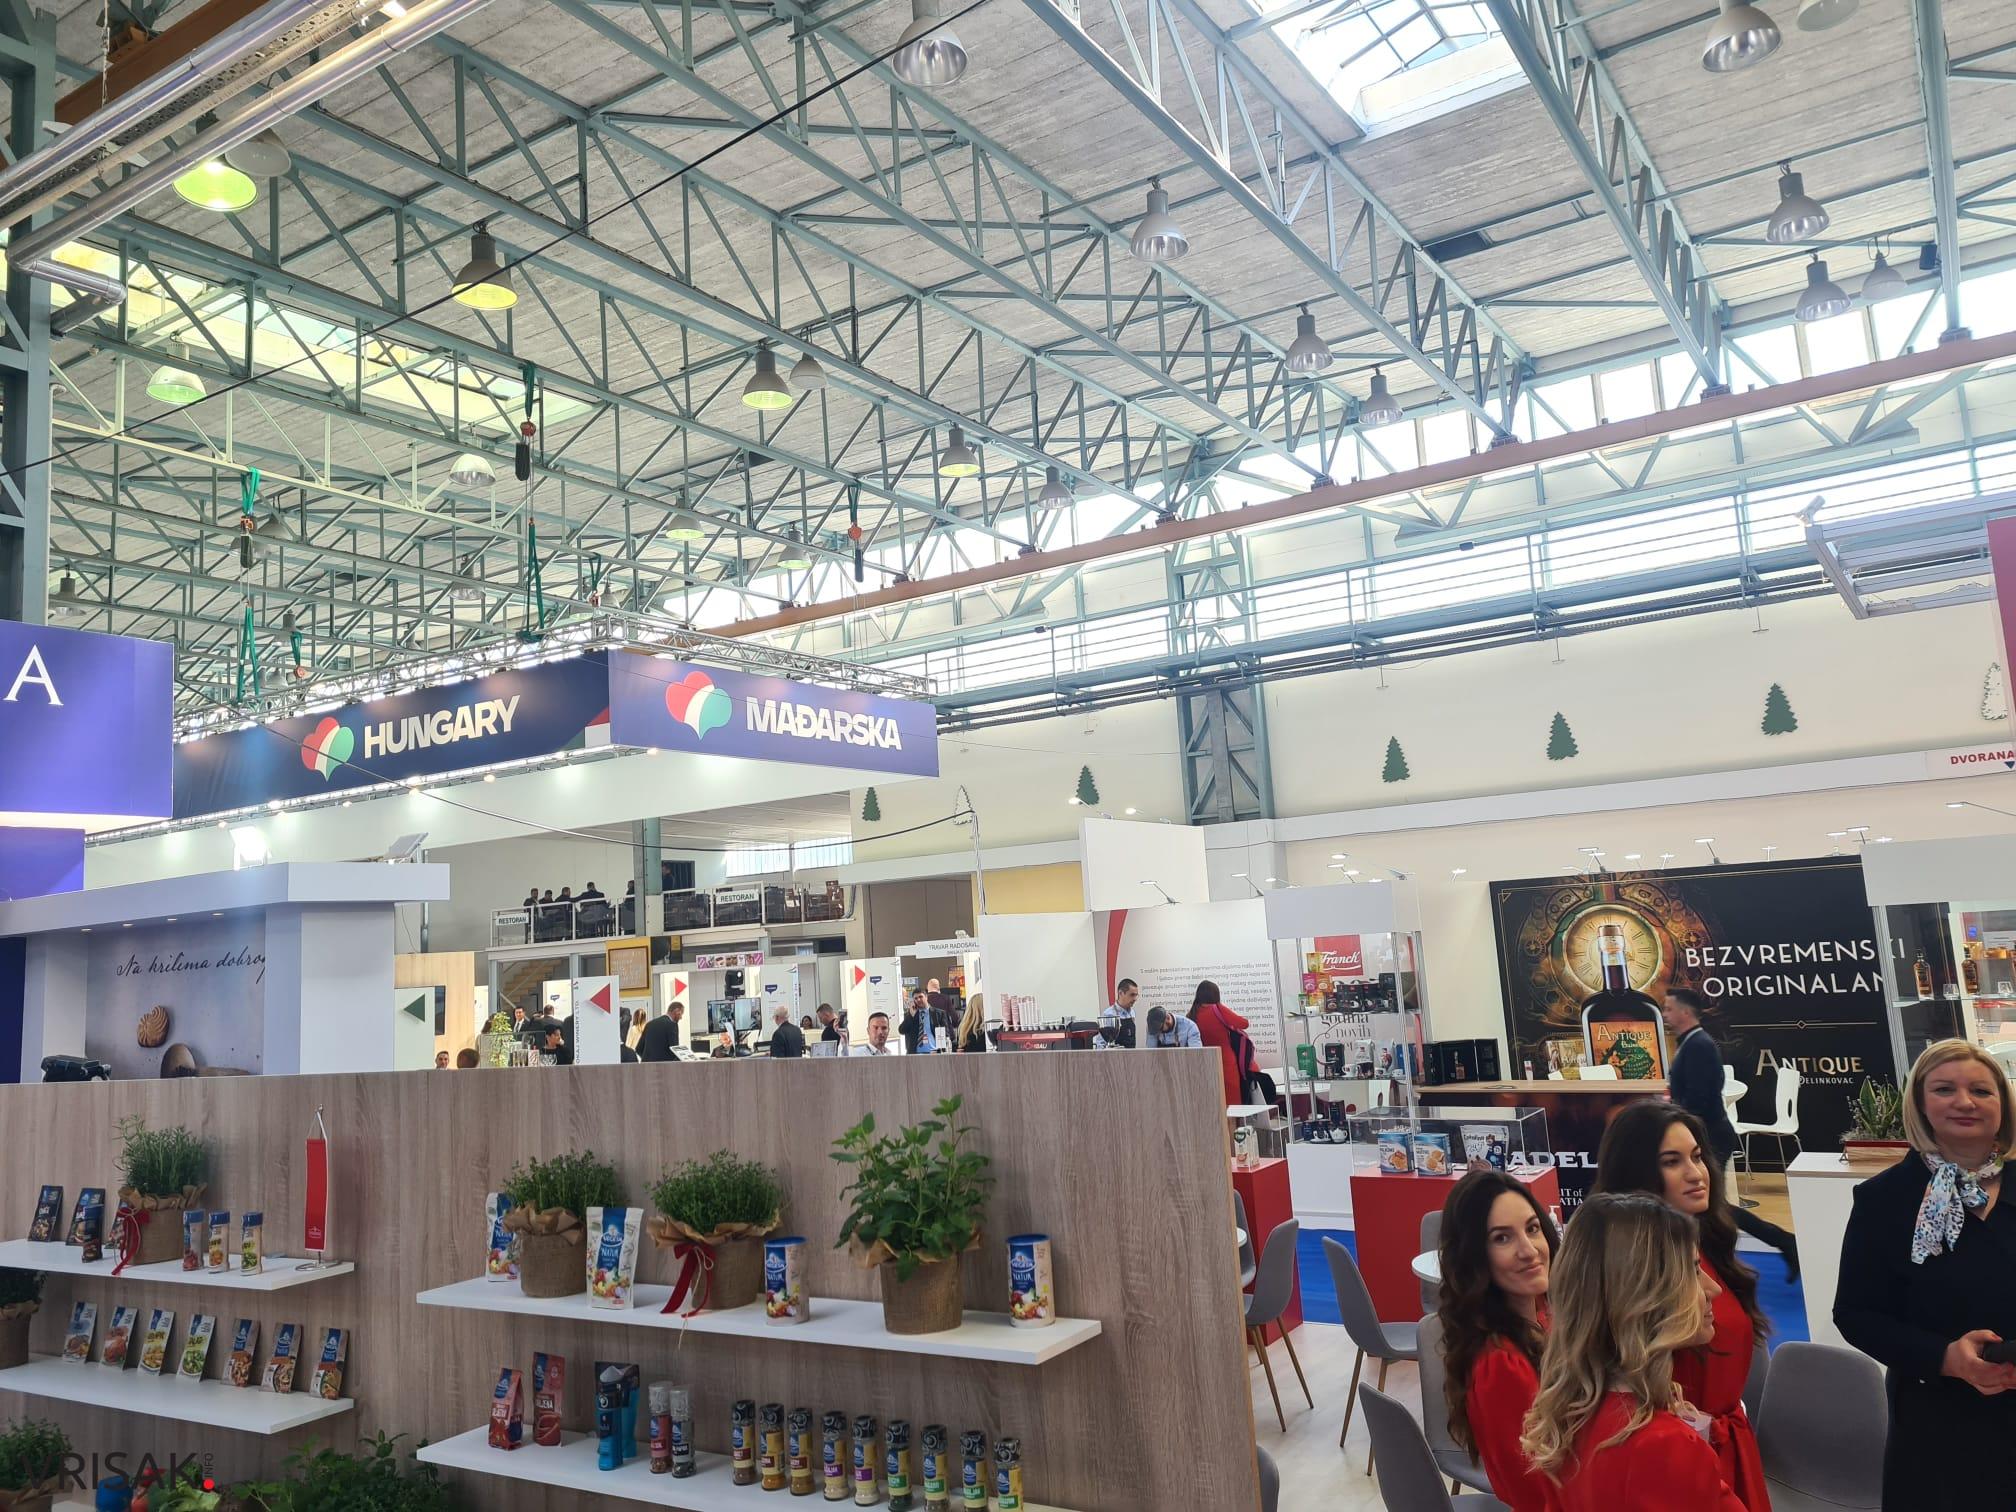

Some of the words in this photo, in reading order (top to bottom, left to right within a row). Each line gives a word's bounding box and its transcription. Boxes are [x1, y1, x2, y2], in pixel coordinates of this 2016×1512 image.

[3, 644, 64, 707] A
[363, 695, 521, 759] HUNGARY
[746, 696, 903, 751] MAĐARSKA
[1950, 750, 2016, 764] DVORANA
[720, 893, 755, 903] RESTORAN
[498, 916, 527, 925] RESTORAN
[117, 954, 142, 976] Na
[149, 951, 210, 974] krilima
[1321, 950, 1360, 965] Franck
[1336, 1024, 1371, 1039] novih
[1597, 1024, 1652, 1041] ANTIQUE
[1755, 1049, 1864, 1077] ANTIQUE
[1505, 1151, 1599, 1169] ADEL
[1559, 1198, 1584, 1206] ATIA
